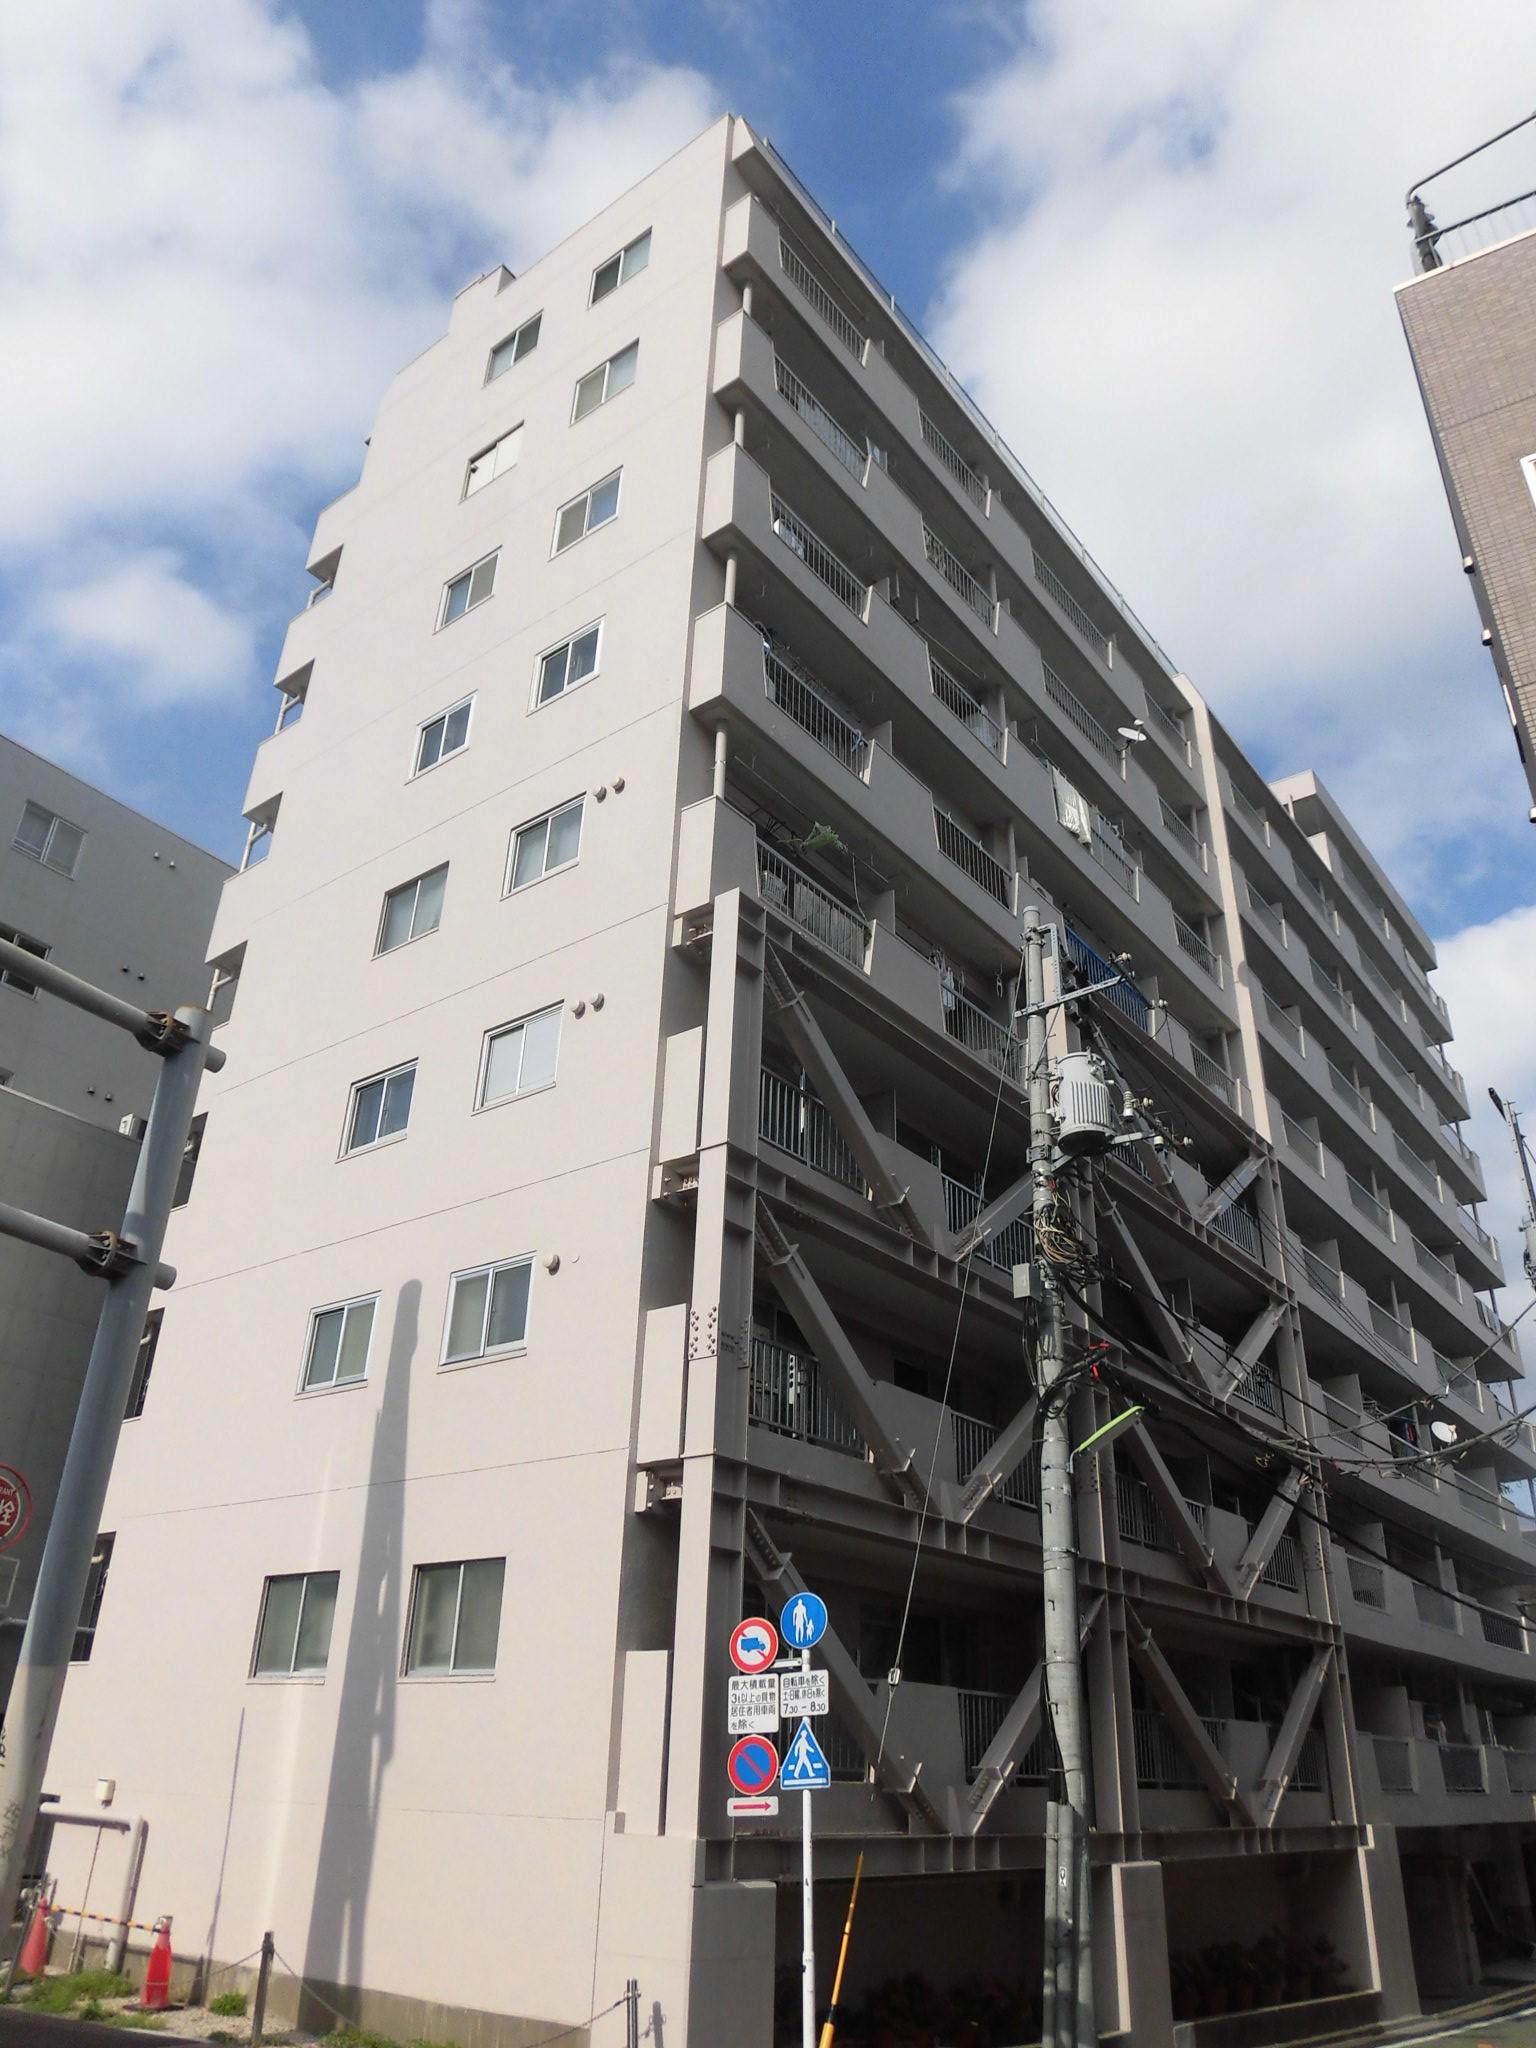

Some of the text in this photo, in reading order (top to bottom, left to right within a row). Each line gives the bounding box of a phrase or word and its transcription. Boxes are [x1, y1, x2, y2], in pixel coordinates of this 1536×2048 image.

[731, 1678, 775, 1690] 最大積載量
[783, 1674, 825, 1688] 自転車を除く
[731, 1705, 775, 1717] 居住者用車両
[731, 1719, 755, 1730] を除く
